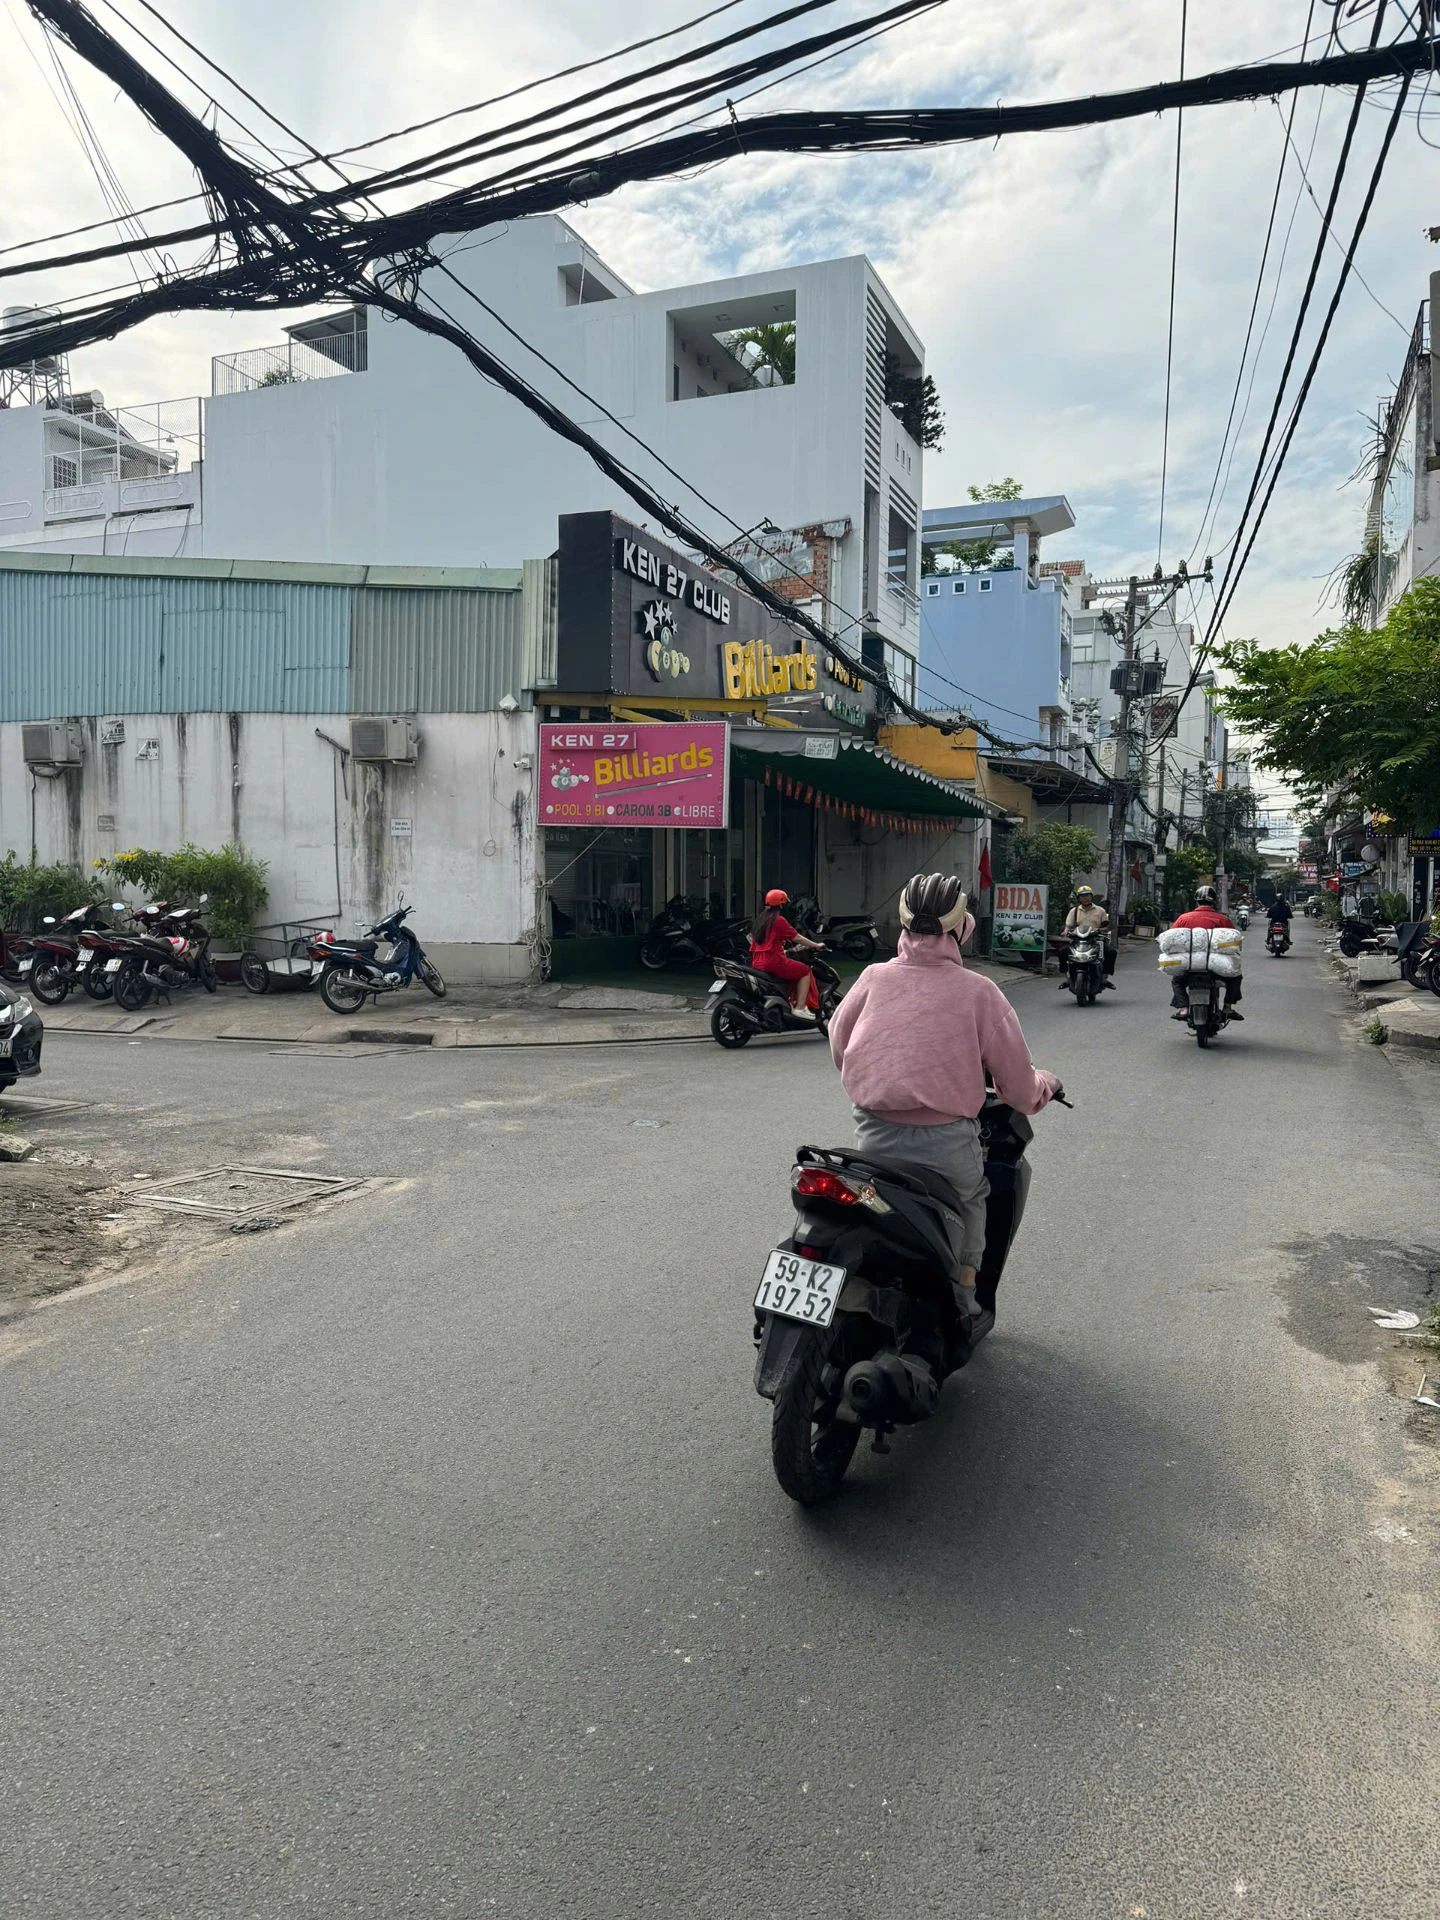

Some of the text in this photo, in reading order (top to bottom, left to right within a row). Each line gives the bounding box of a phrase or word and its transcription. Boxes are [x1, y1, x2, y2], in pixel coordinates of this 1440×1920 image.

[623, 538, 730, 625] KEN 27 CLUB
[722, 639, 817, 699] Billiards
[551, 734, 629, 747] KEN 27
[593, 742, 714, 786] Billiards
[554, 804, 582, 816] POOL
[585, 804, 591, 816] 9
[615, 804, 654, 817] CAROM
[657, 804, 672, 817] 3B
[682, 805, 715, 818] LIBRE
[996, 887, 1043, 912] BIDA
[775, 1256, 833, 1293] 59-K2
[761, 1281, 831, 1323] 197.52
